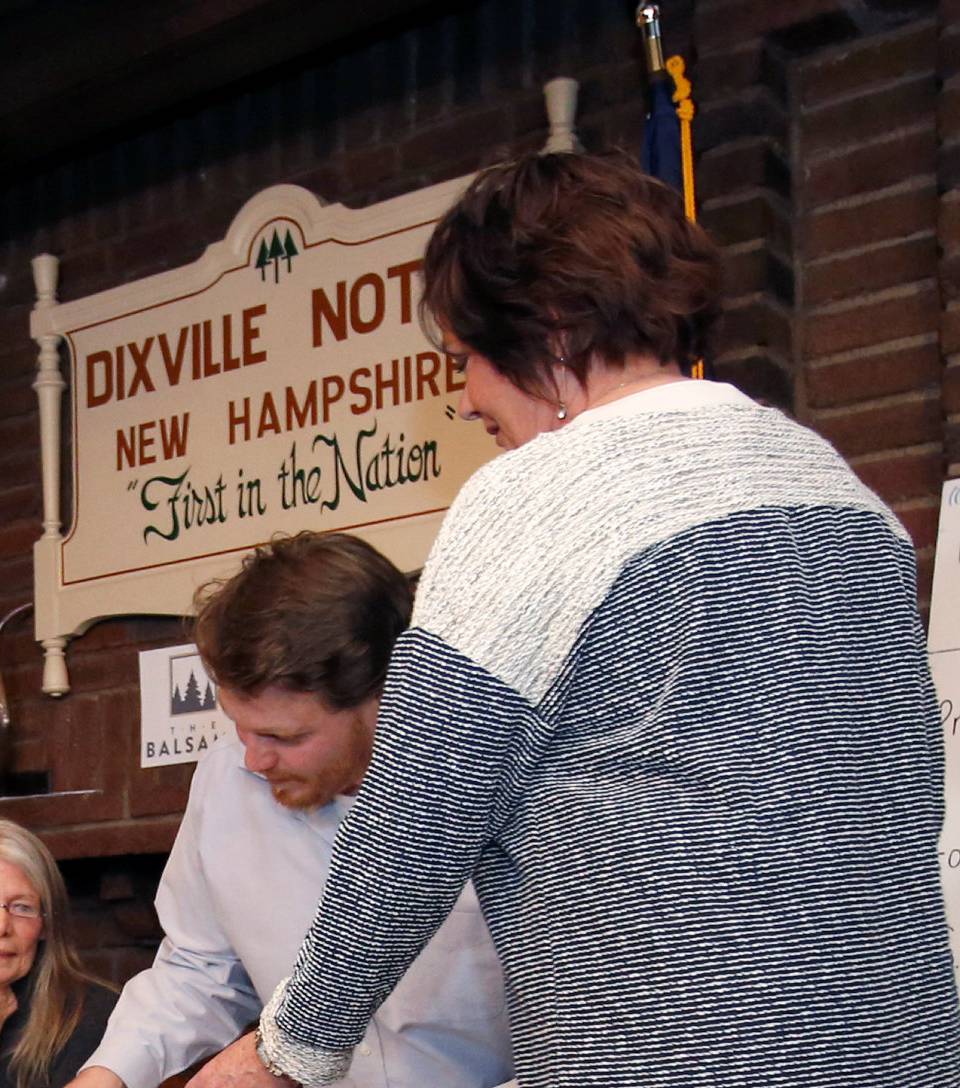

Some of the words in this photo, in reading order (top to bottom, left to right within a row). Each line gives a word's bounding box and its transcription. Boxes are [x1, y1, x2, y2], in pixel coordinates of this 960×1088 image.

[86, 304, 268, 408] DIXVILLE
[312, 259, 424, 348] NOT
[116, 413, 190, 471] NEW
[228, 351, 467, 445] HAMPSHIRE
[238, 468, 267, 519] in
[278, 442, 322, 509] the
[147, 735, 218, 757] BALSA
